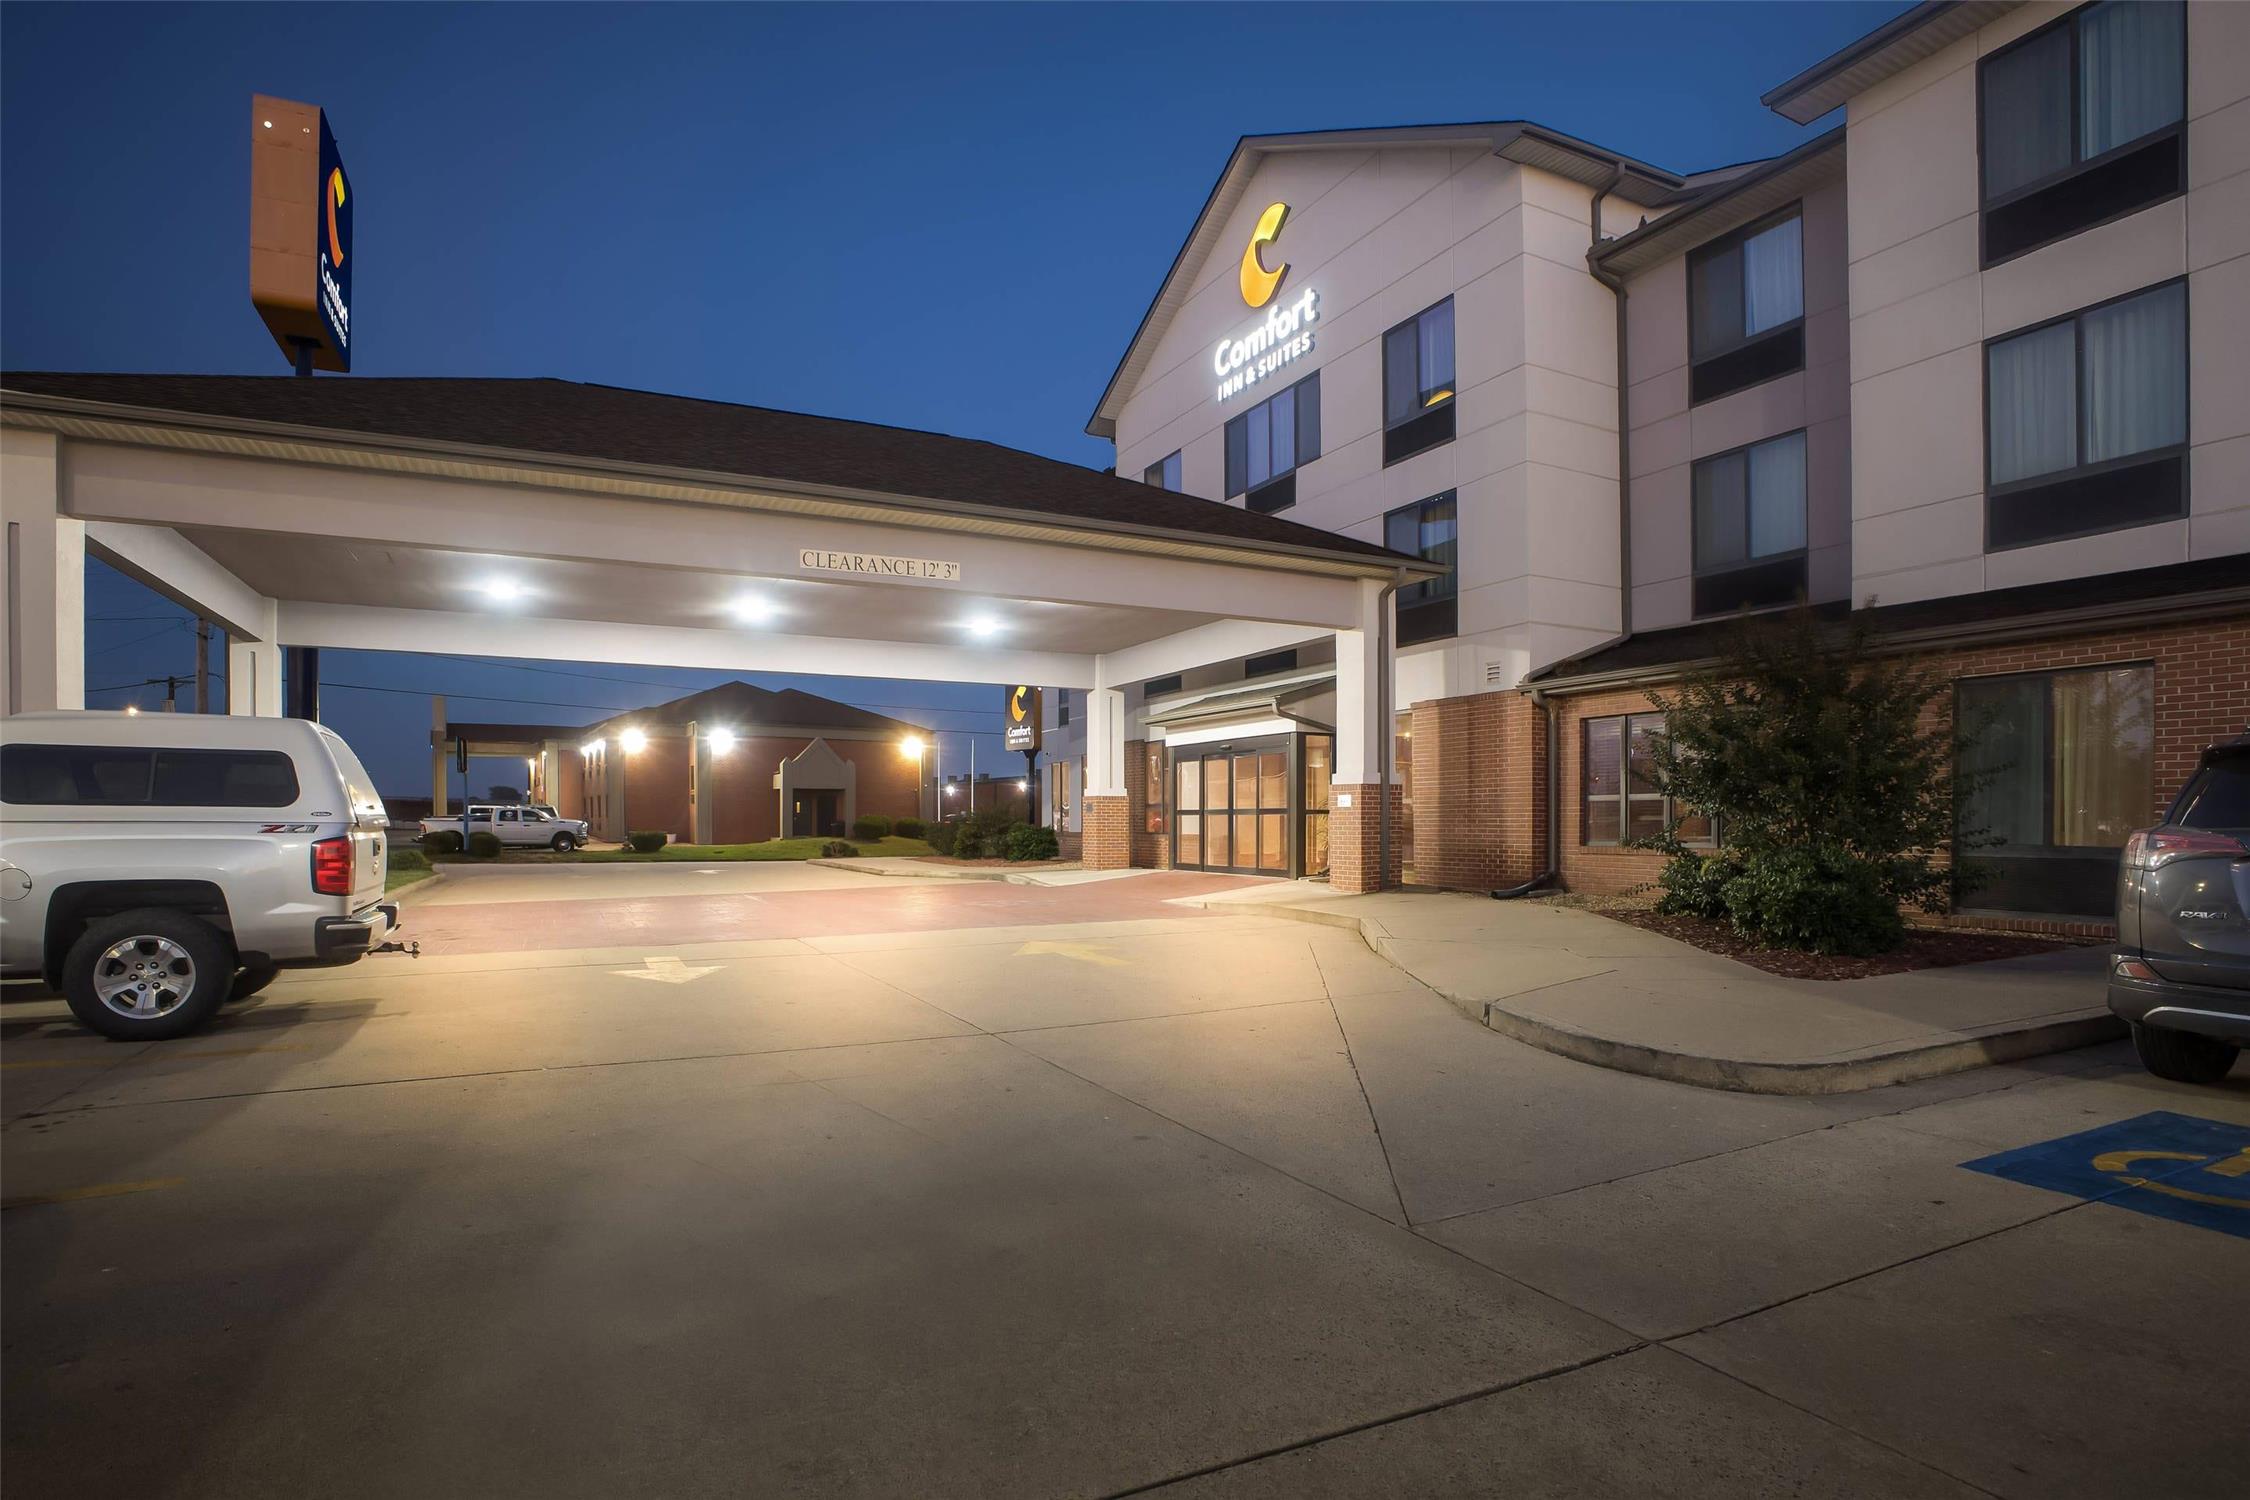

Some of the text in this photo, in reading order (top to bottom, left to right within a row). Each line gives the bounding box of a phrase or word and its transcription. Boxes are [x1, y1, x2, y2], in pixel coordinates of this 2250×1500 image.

[321, 252, 349, 332] Comfort
[1214, 288, 1317, 377] Comfort
[1217, 331, 1313, 402] INN & SUITES
[802, 550, 917, 577] CLEARANCE
[922, 561, 940, 578] 12'
[1007, 725, 1031, 738] Comfort
[257, 824, 319, 834] Z71
